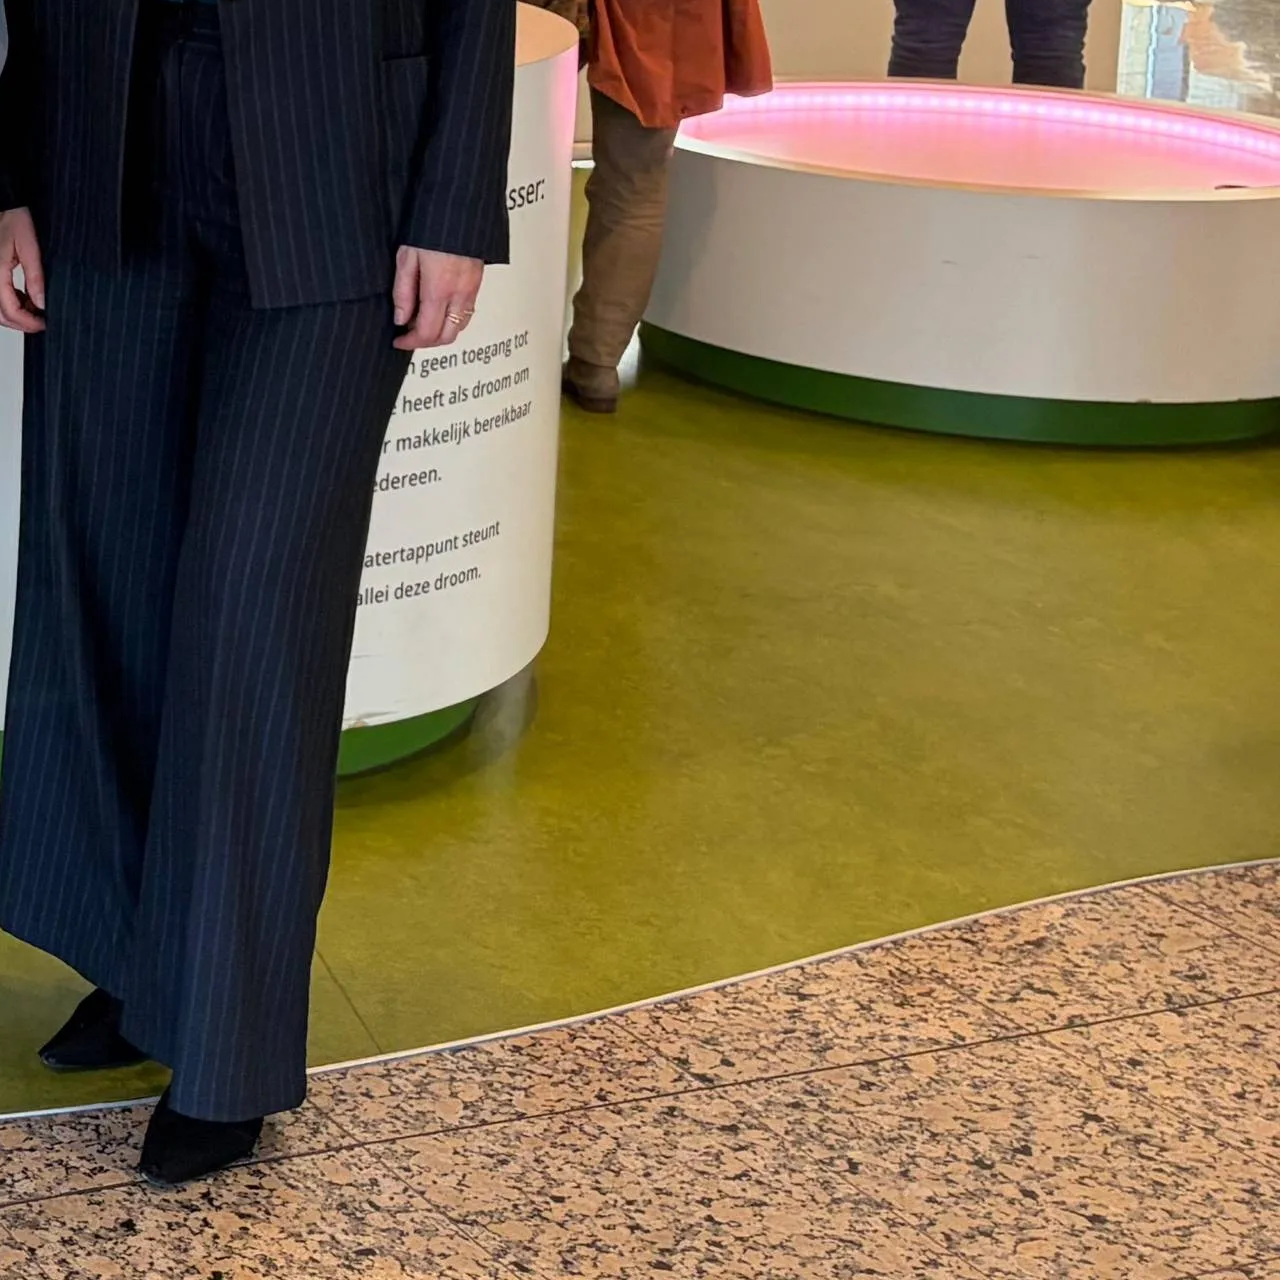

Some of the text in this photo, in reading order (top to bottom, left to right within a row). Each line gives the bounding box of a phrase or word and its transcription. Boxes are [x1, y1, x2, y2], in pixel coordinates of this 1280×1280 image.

[508, 178, 545, 210] sser:
[420, 354, 457, 377] geen
[462, 338, 511, 364] toegang
[514, 330, 528, 349] tot
[403, 390, 444, 413] heeft
[448, 386, 468, 404] als
[472, 375, 511, 399] droom
[514, 367, 529, 385] om
[396, 421, 470, 452] makkelijk
[474, 400, 531, 434] bereikbaar
[364, 521, 500, 567] atertappunt steunt
[394, 581, 430, 599] deze
[434, 566, 481, 590] droom.
